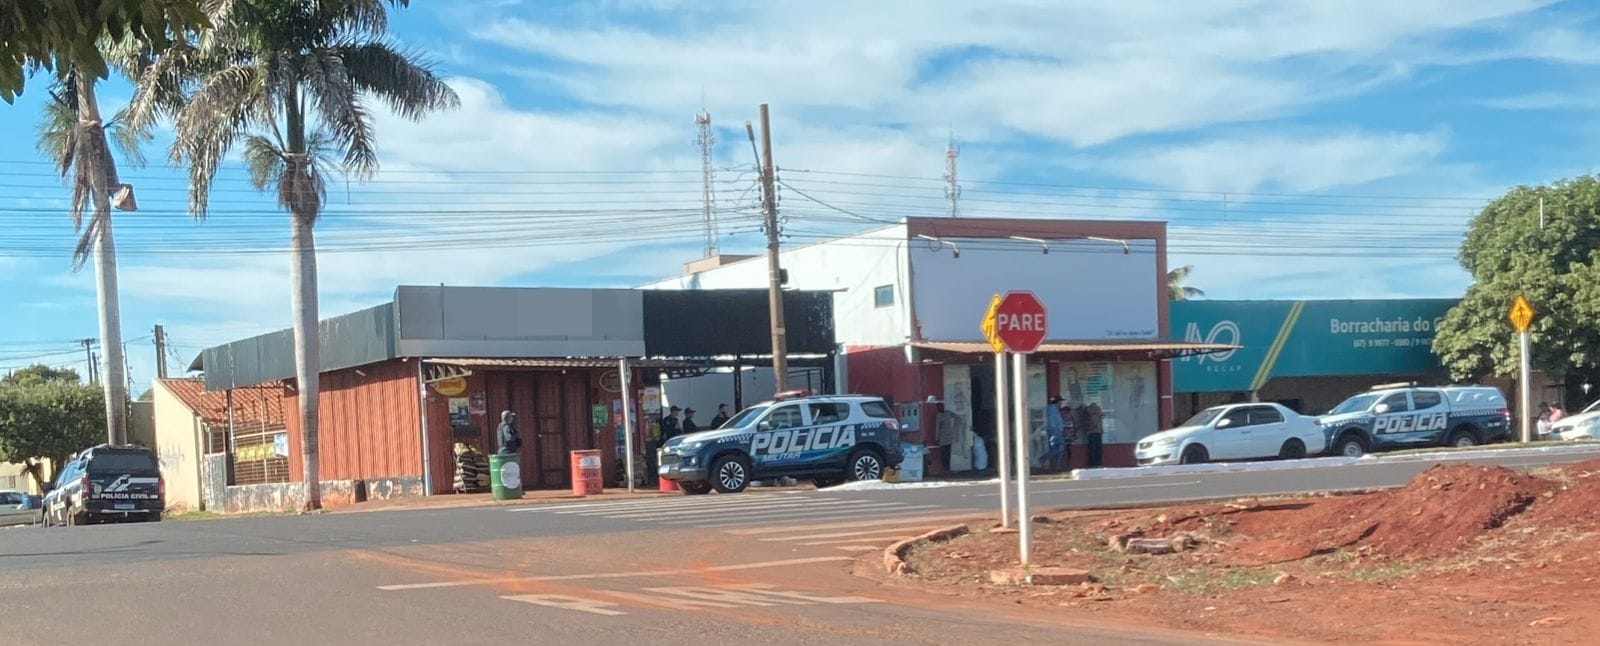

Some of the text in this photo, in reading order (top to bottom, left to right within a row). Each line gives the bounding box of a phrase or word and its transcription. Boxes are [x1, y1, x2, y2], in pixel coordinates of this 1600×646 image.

[997, 313, 1045, 331] PARE
[1330, 317, 1410, 334] Borracharia
[1413, 317, 1431, 332] do
[761, 451, 801, 463] MILITAR
